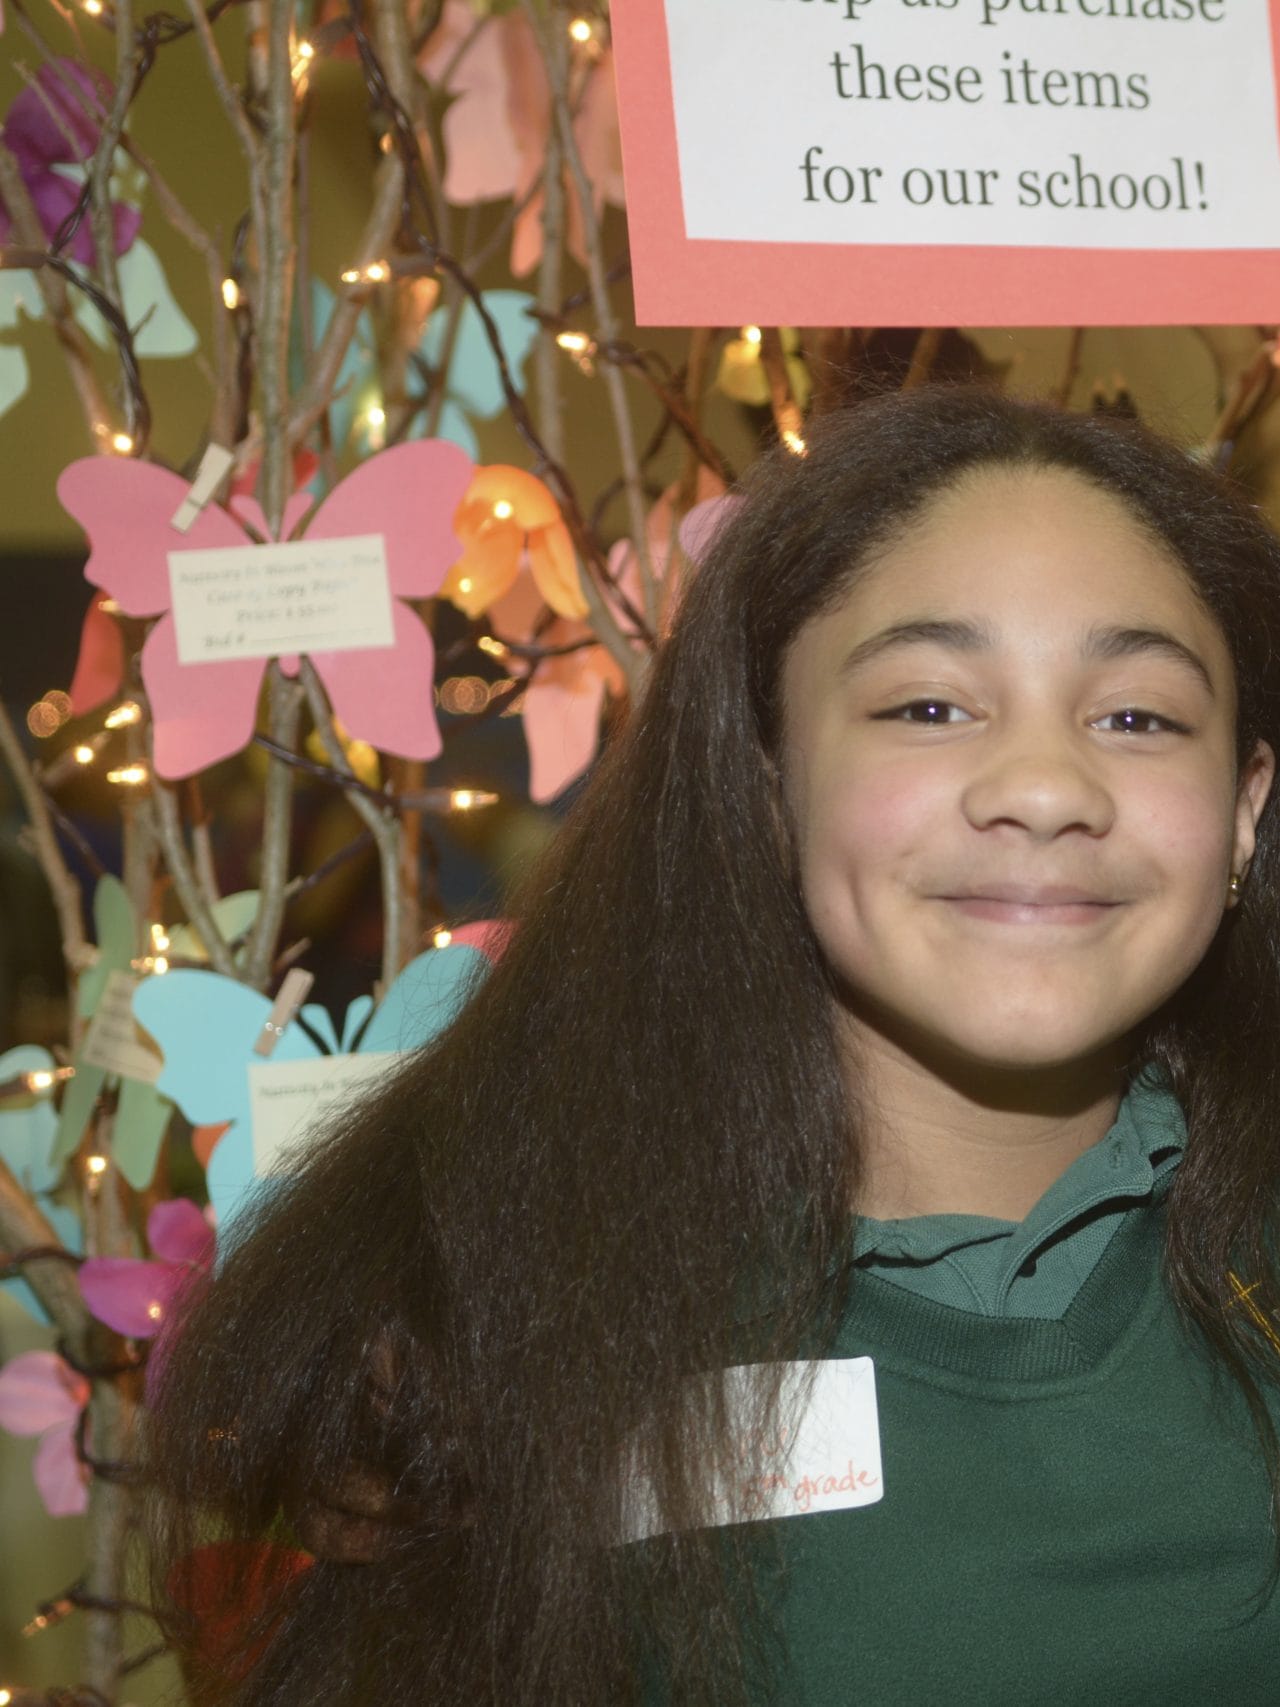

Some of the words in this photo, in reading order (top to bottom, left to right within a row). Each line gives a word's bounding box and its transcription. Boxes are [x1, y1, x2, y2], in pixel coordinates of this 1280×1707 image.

[829, 43, 984, 103] these
[1000, 50, 1151, 110] items
[798, 146, 884, 204] for
[901, 168, 1000, 207] our
[1017, 153, 1209, 211] school!
[794, 1460, 878, 1512] grade
